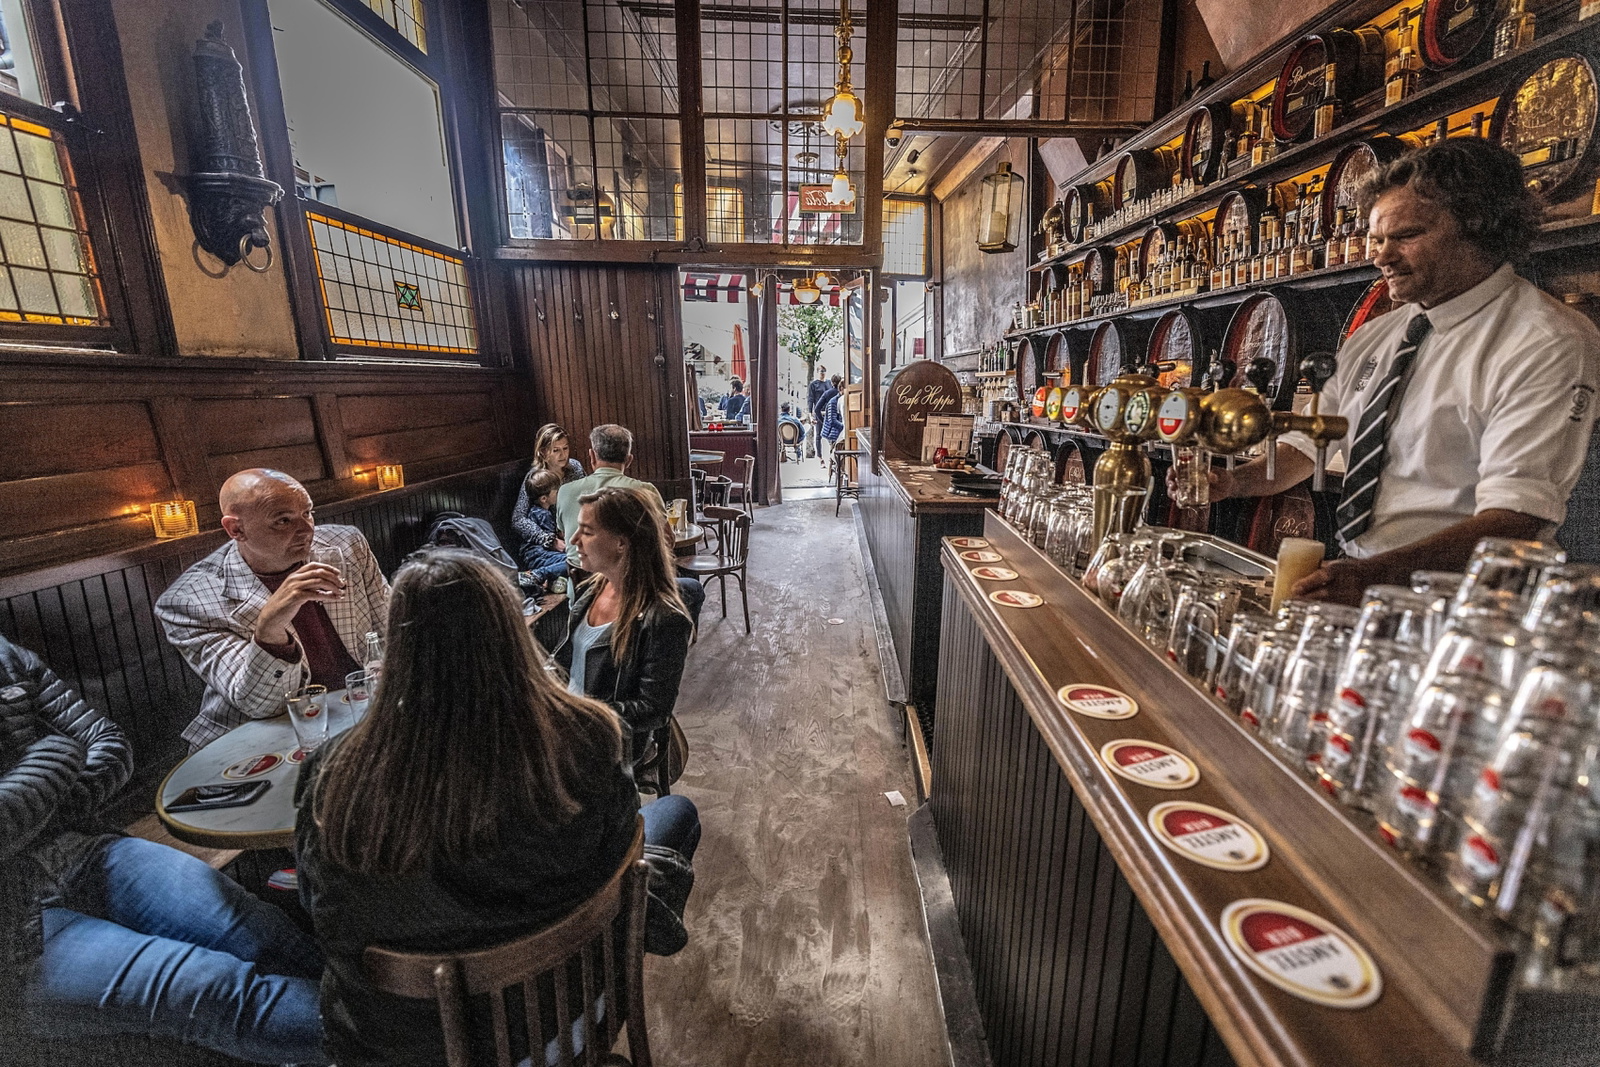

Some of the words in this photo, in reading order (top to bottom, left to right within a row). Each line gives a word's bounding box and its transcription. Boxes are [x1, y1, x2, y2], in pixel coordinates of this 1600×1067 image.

[920, 385, 955, 411] Hoppe
[1131, 757, 1179, 775] AMSTEL
[1183, 828, 1242, 849] AMSTEL
[1268, 942, 1340, 970] AMSTEL
